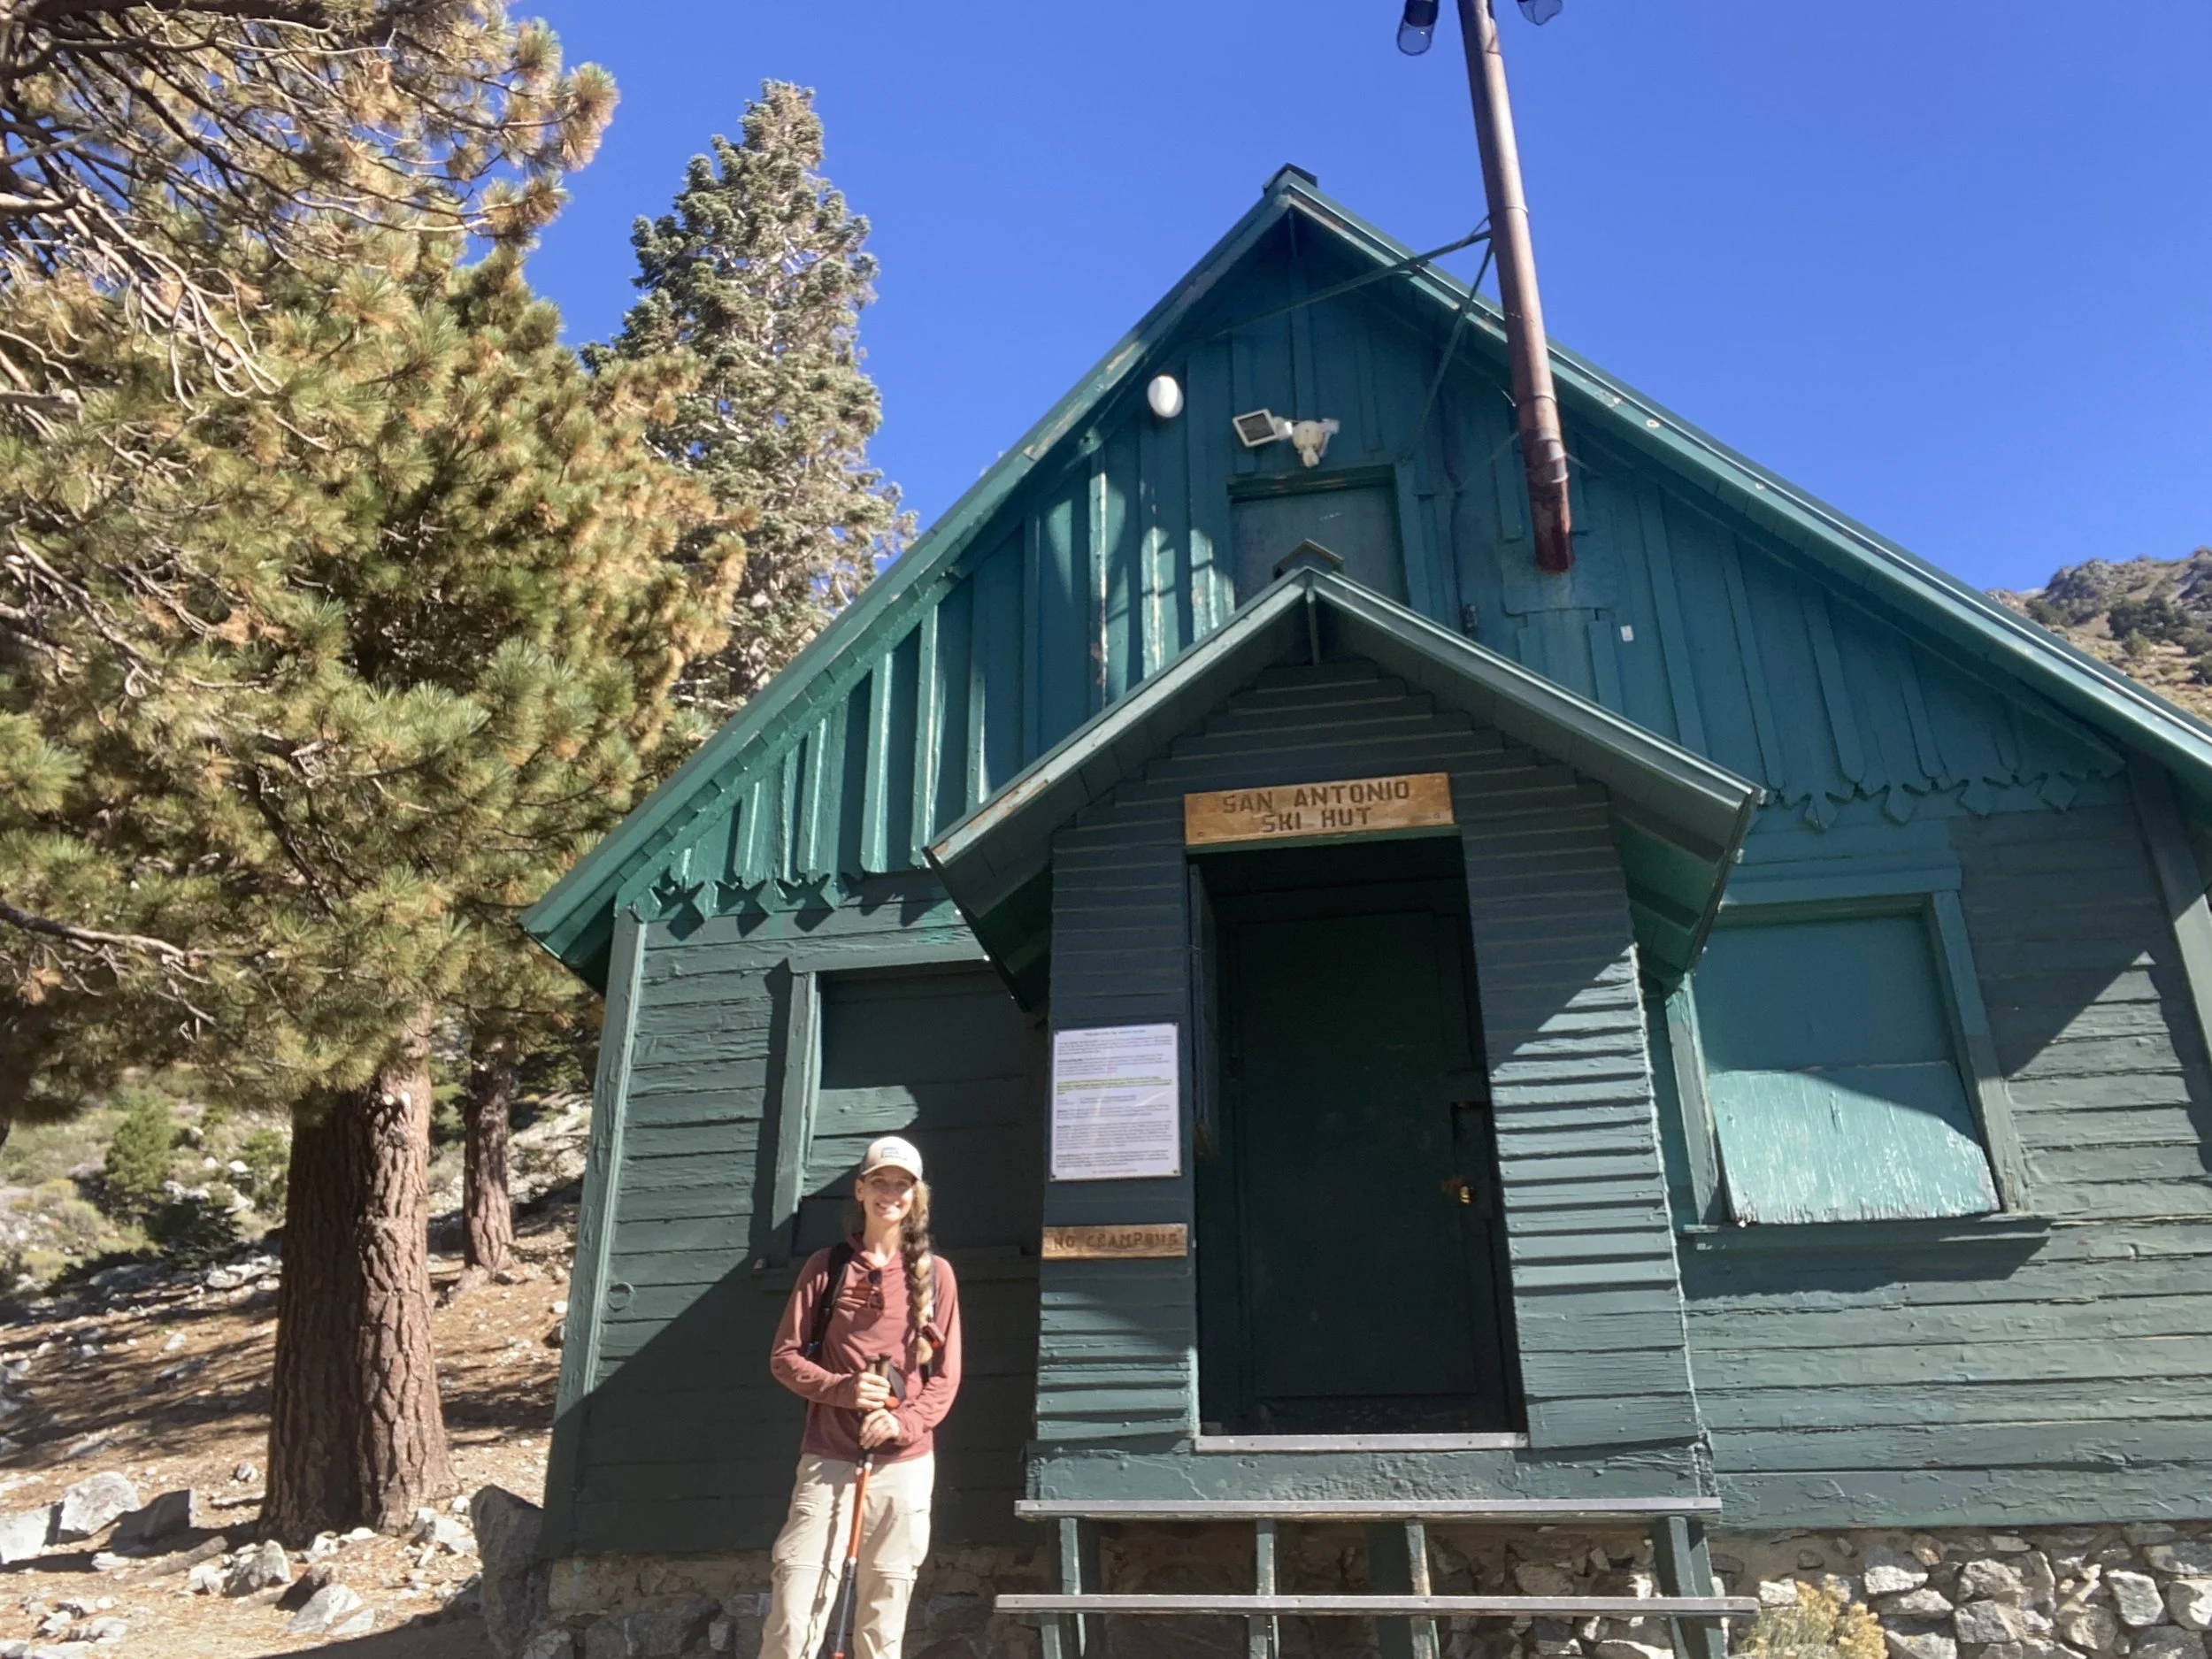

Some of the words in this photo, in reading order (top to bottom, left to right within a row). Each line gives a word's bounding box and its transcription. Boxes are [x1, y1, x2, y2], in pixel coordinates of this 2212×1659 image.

[1222, 791, 1272, 813] SAN
[1294, 780, 1409, 807] ANTONIO
[1262, 811, 1302, 833] SKI
[1321, 807, 1371, 827] HUT
[1054, 1235, 1075, 1248] NO
